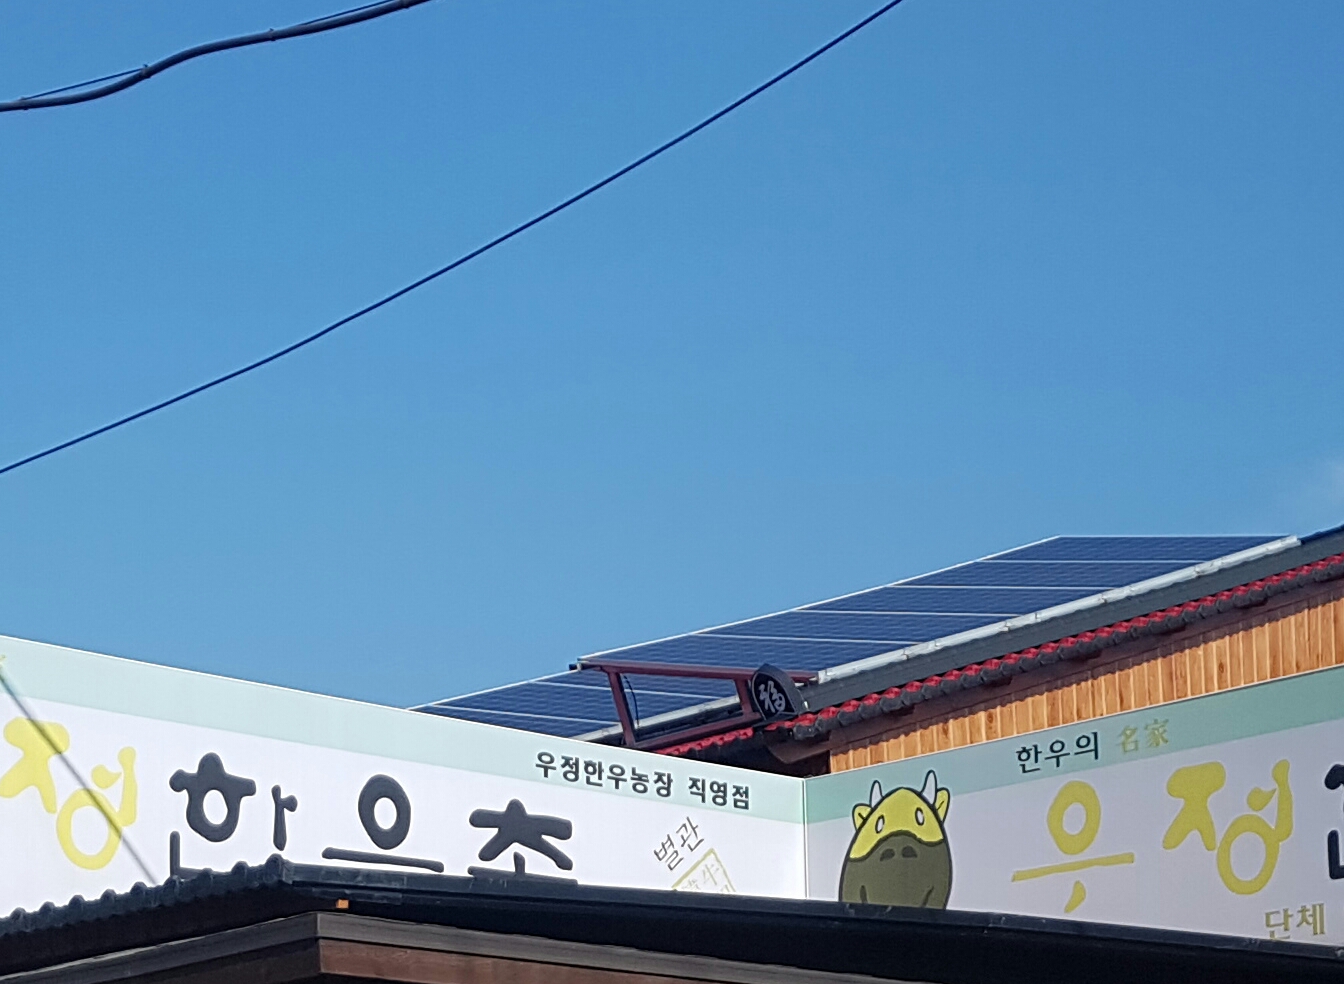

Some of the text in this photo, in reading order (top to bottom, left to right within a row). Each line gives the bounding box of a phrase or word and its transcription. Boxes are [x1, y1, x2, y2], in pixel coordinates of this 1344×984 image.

[1015, 718, 1170, 774] 한우의 名家
[535, 751, 751, 811] 우정한우농장 직영점
[654, 816, 704, 871] 별관
[1265, 903, 1327, 942] 단체
